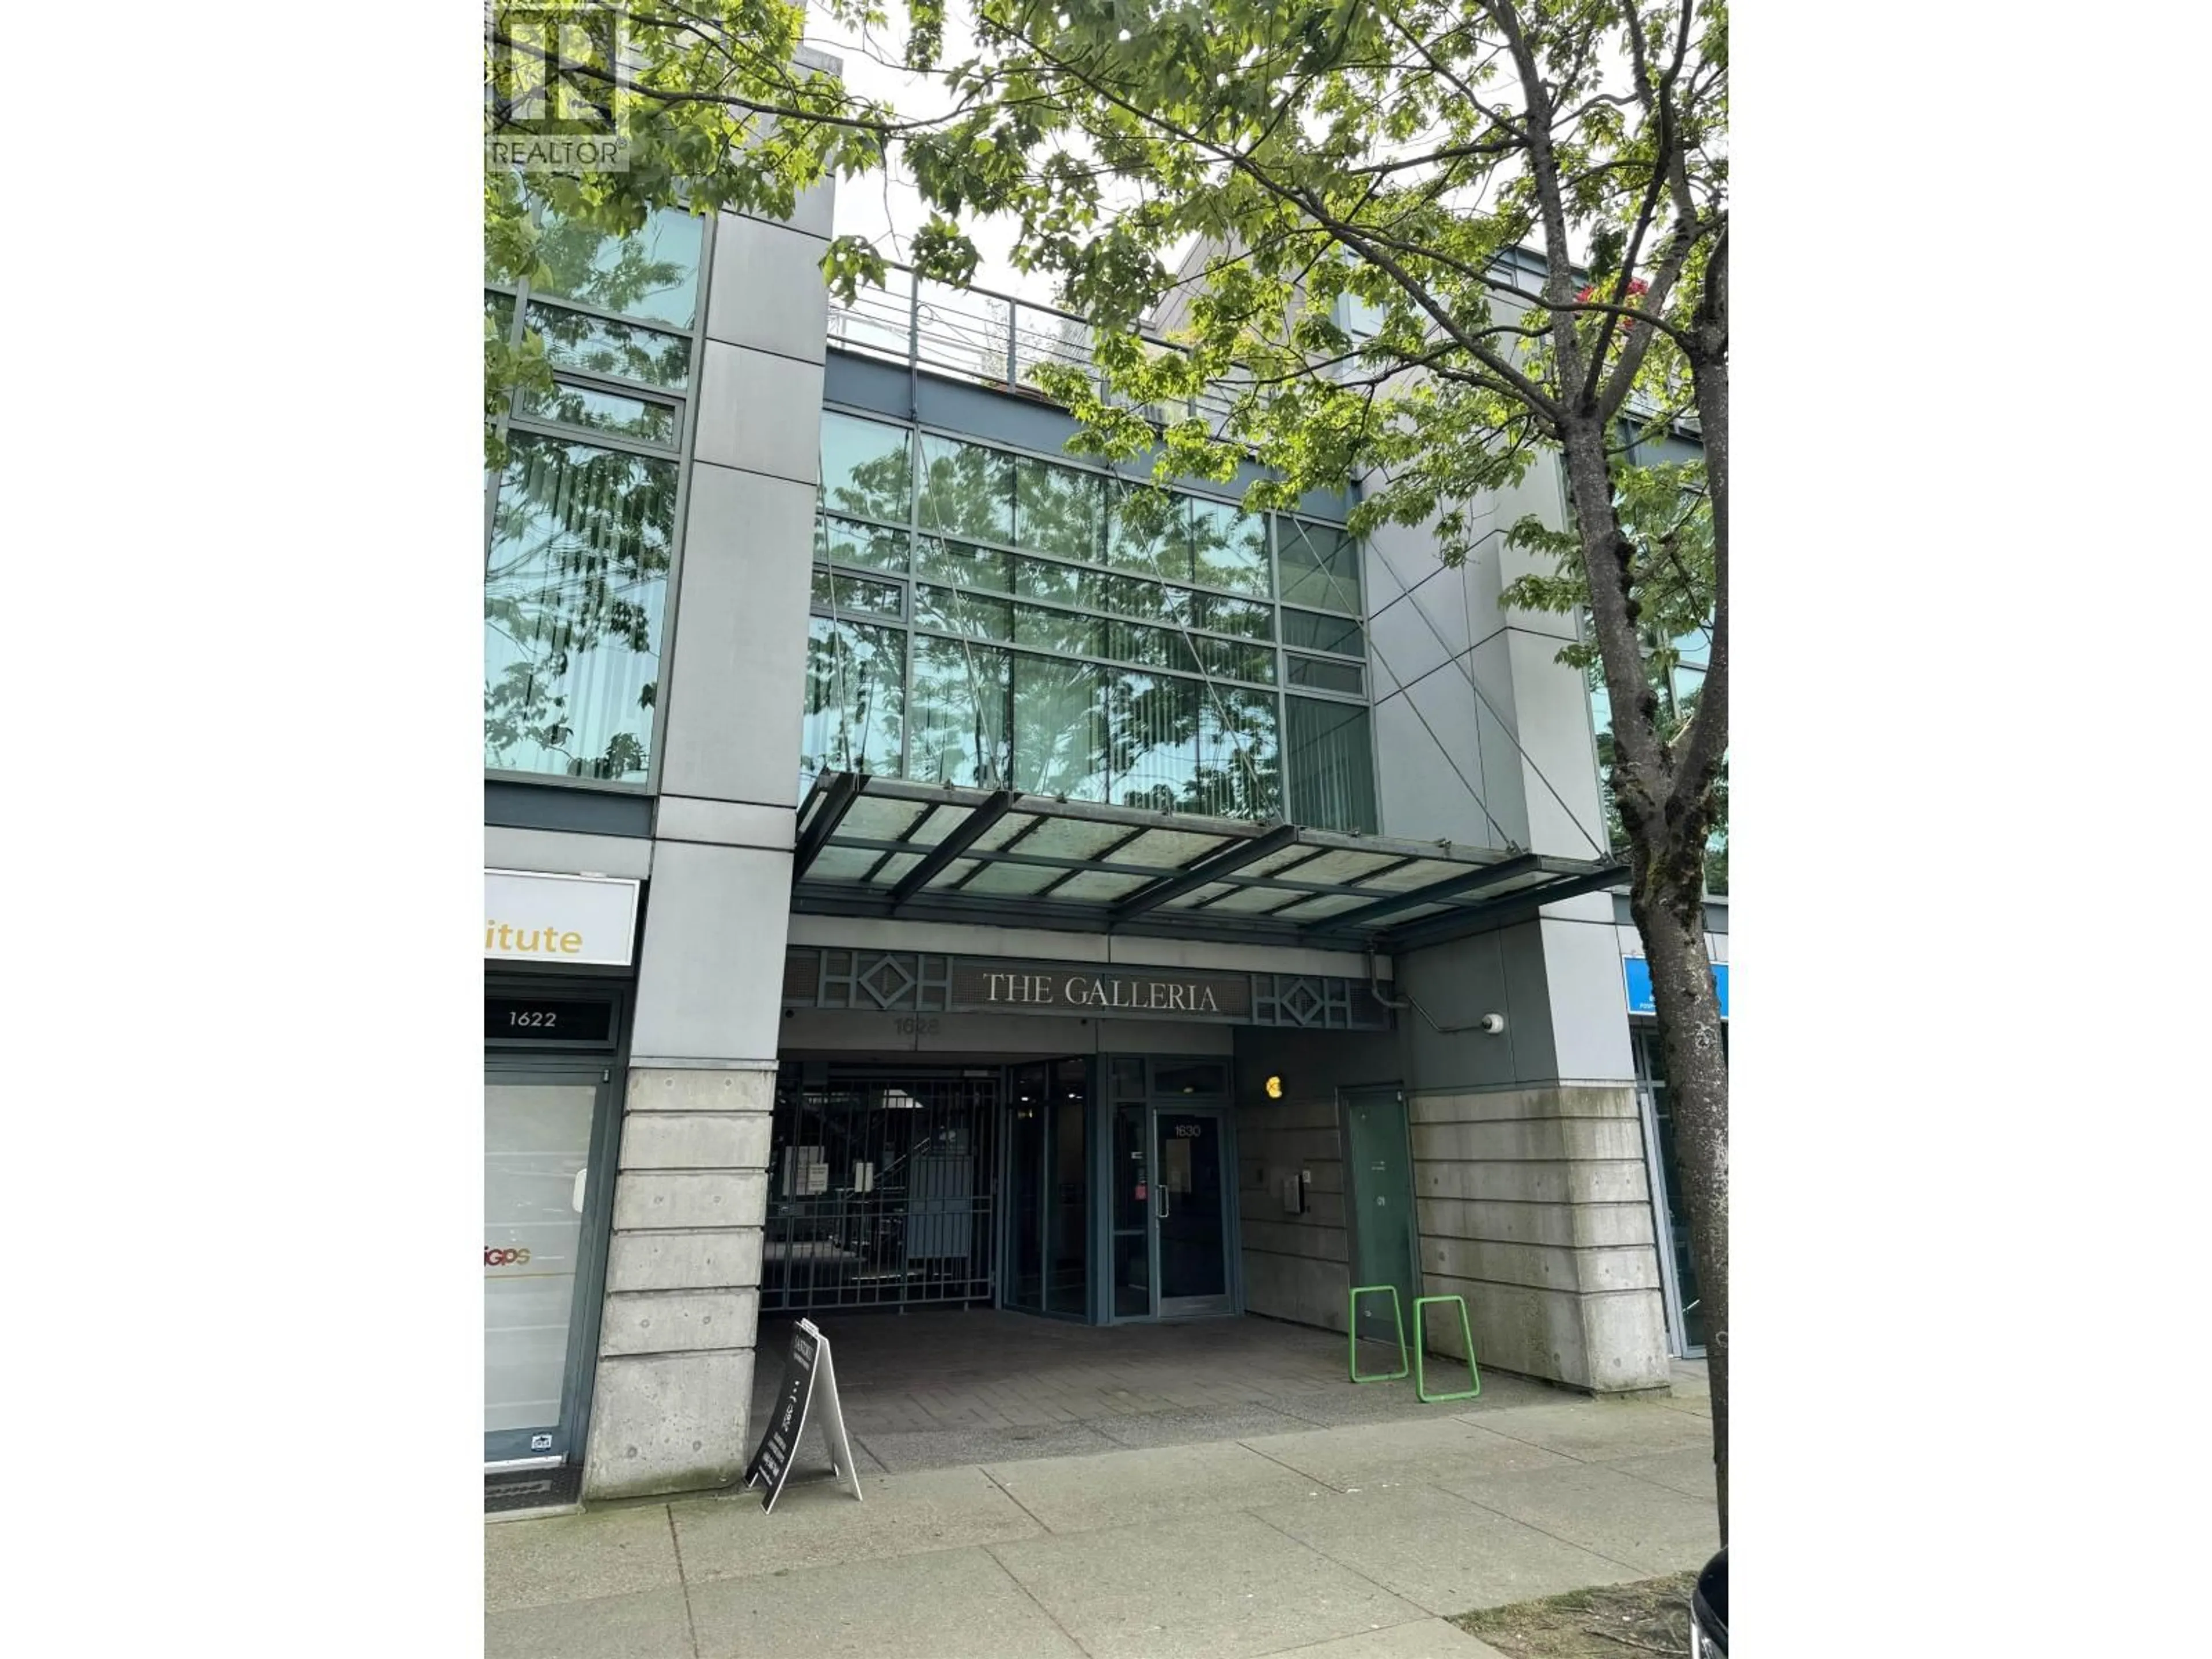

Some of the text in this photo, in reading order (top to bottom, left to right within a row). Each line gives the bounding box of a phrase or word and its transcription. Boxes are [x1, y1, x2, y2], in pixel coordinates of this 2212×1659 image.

[486, 919, 583, 953] itute
[983, 973, 1219, 1012] THE GALLERIA
[510, 1012, 556, 1027] 1622
[1175, 1124, 1201, 1138] 1630
